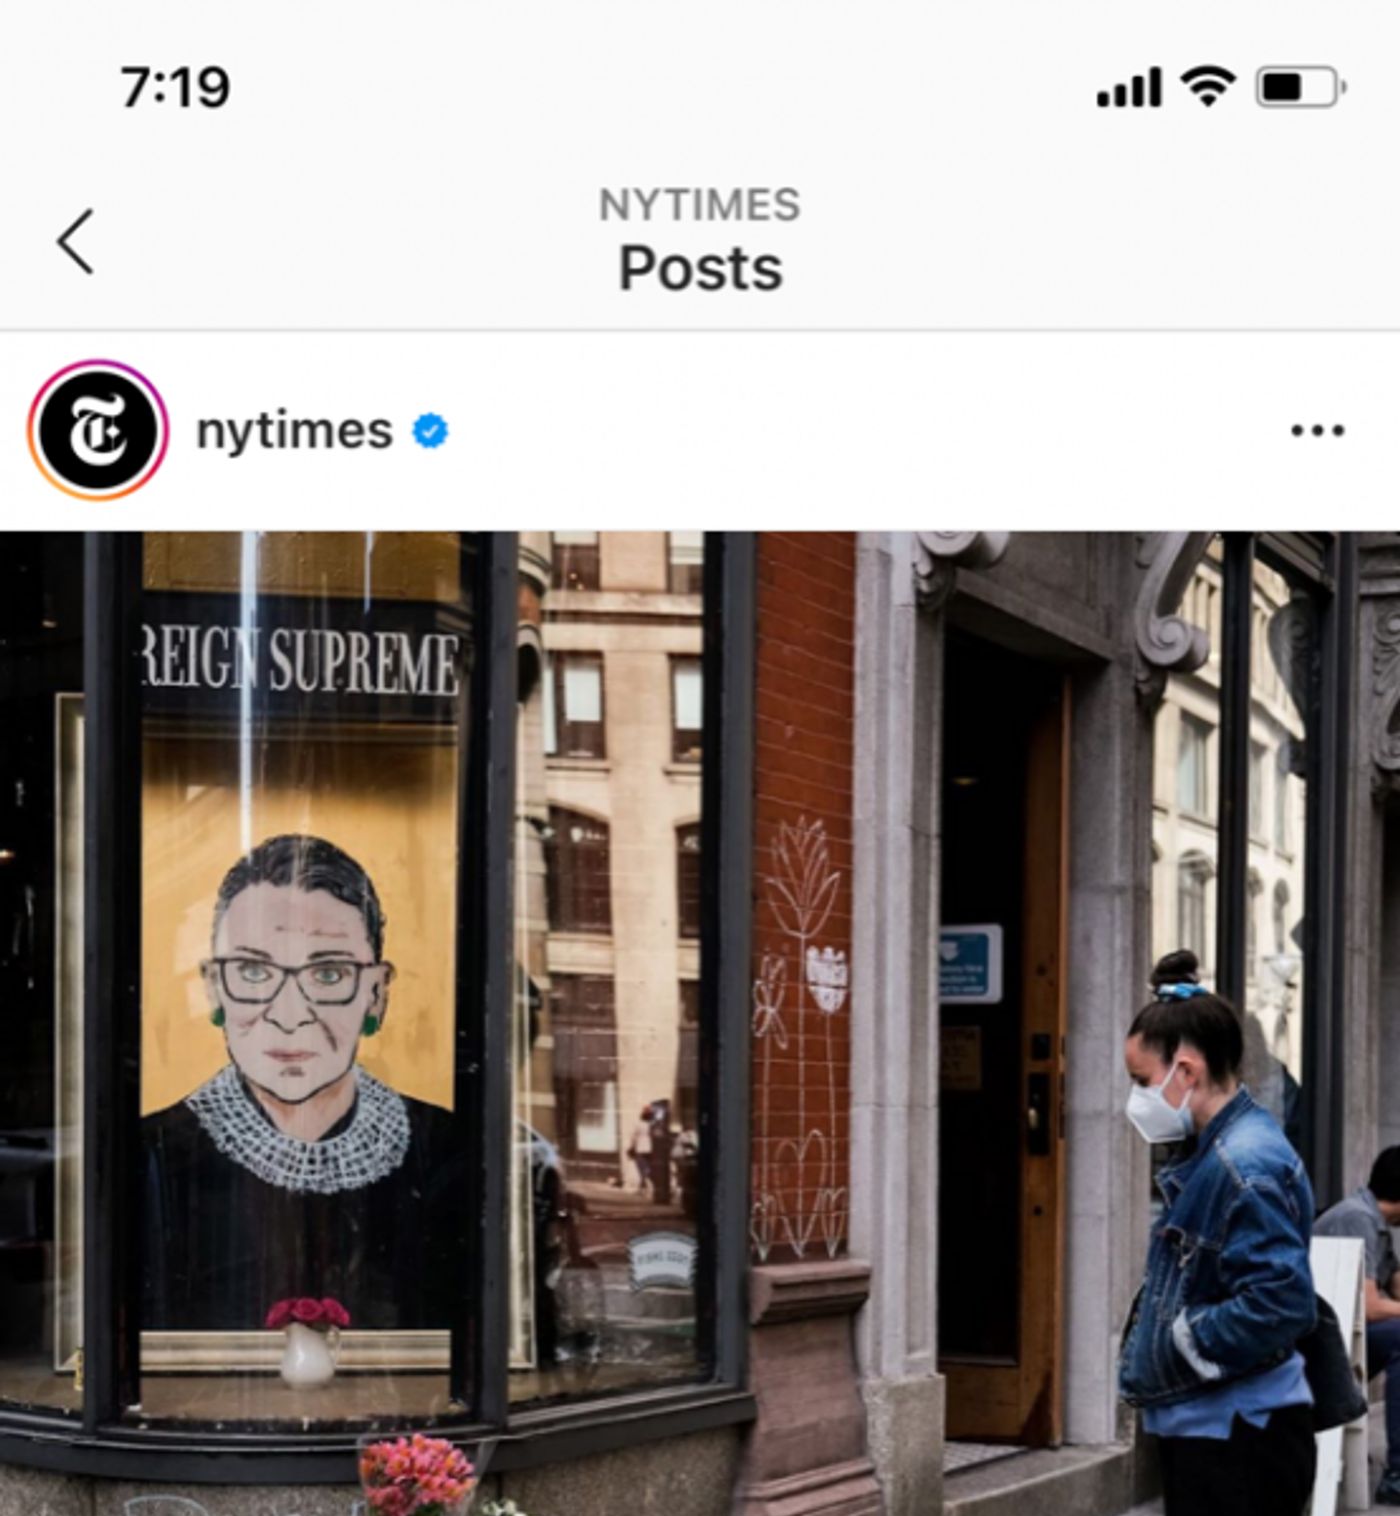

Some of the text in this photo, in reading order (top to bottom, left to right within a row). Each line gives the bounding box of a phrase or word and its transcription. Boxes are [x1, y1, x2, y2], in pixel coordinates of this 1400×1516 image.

[119, 63, 233, 111] 7:19
[599, 185, 802, 223] NYTIMES
[618, 241, 785, 294] Posts
[195, 405, 395, 461] nytimes
[269, 627, 459, 697] SUPREME
